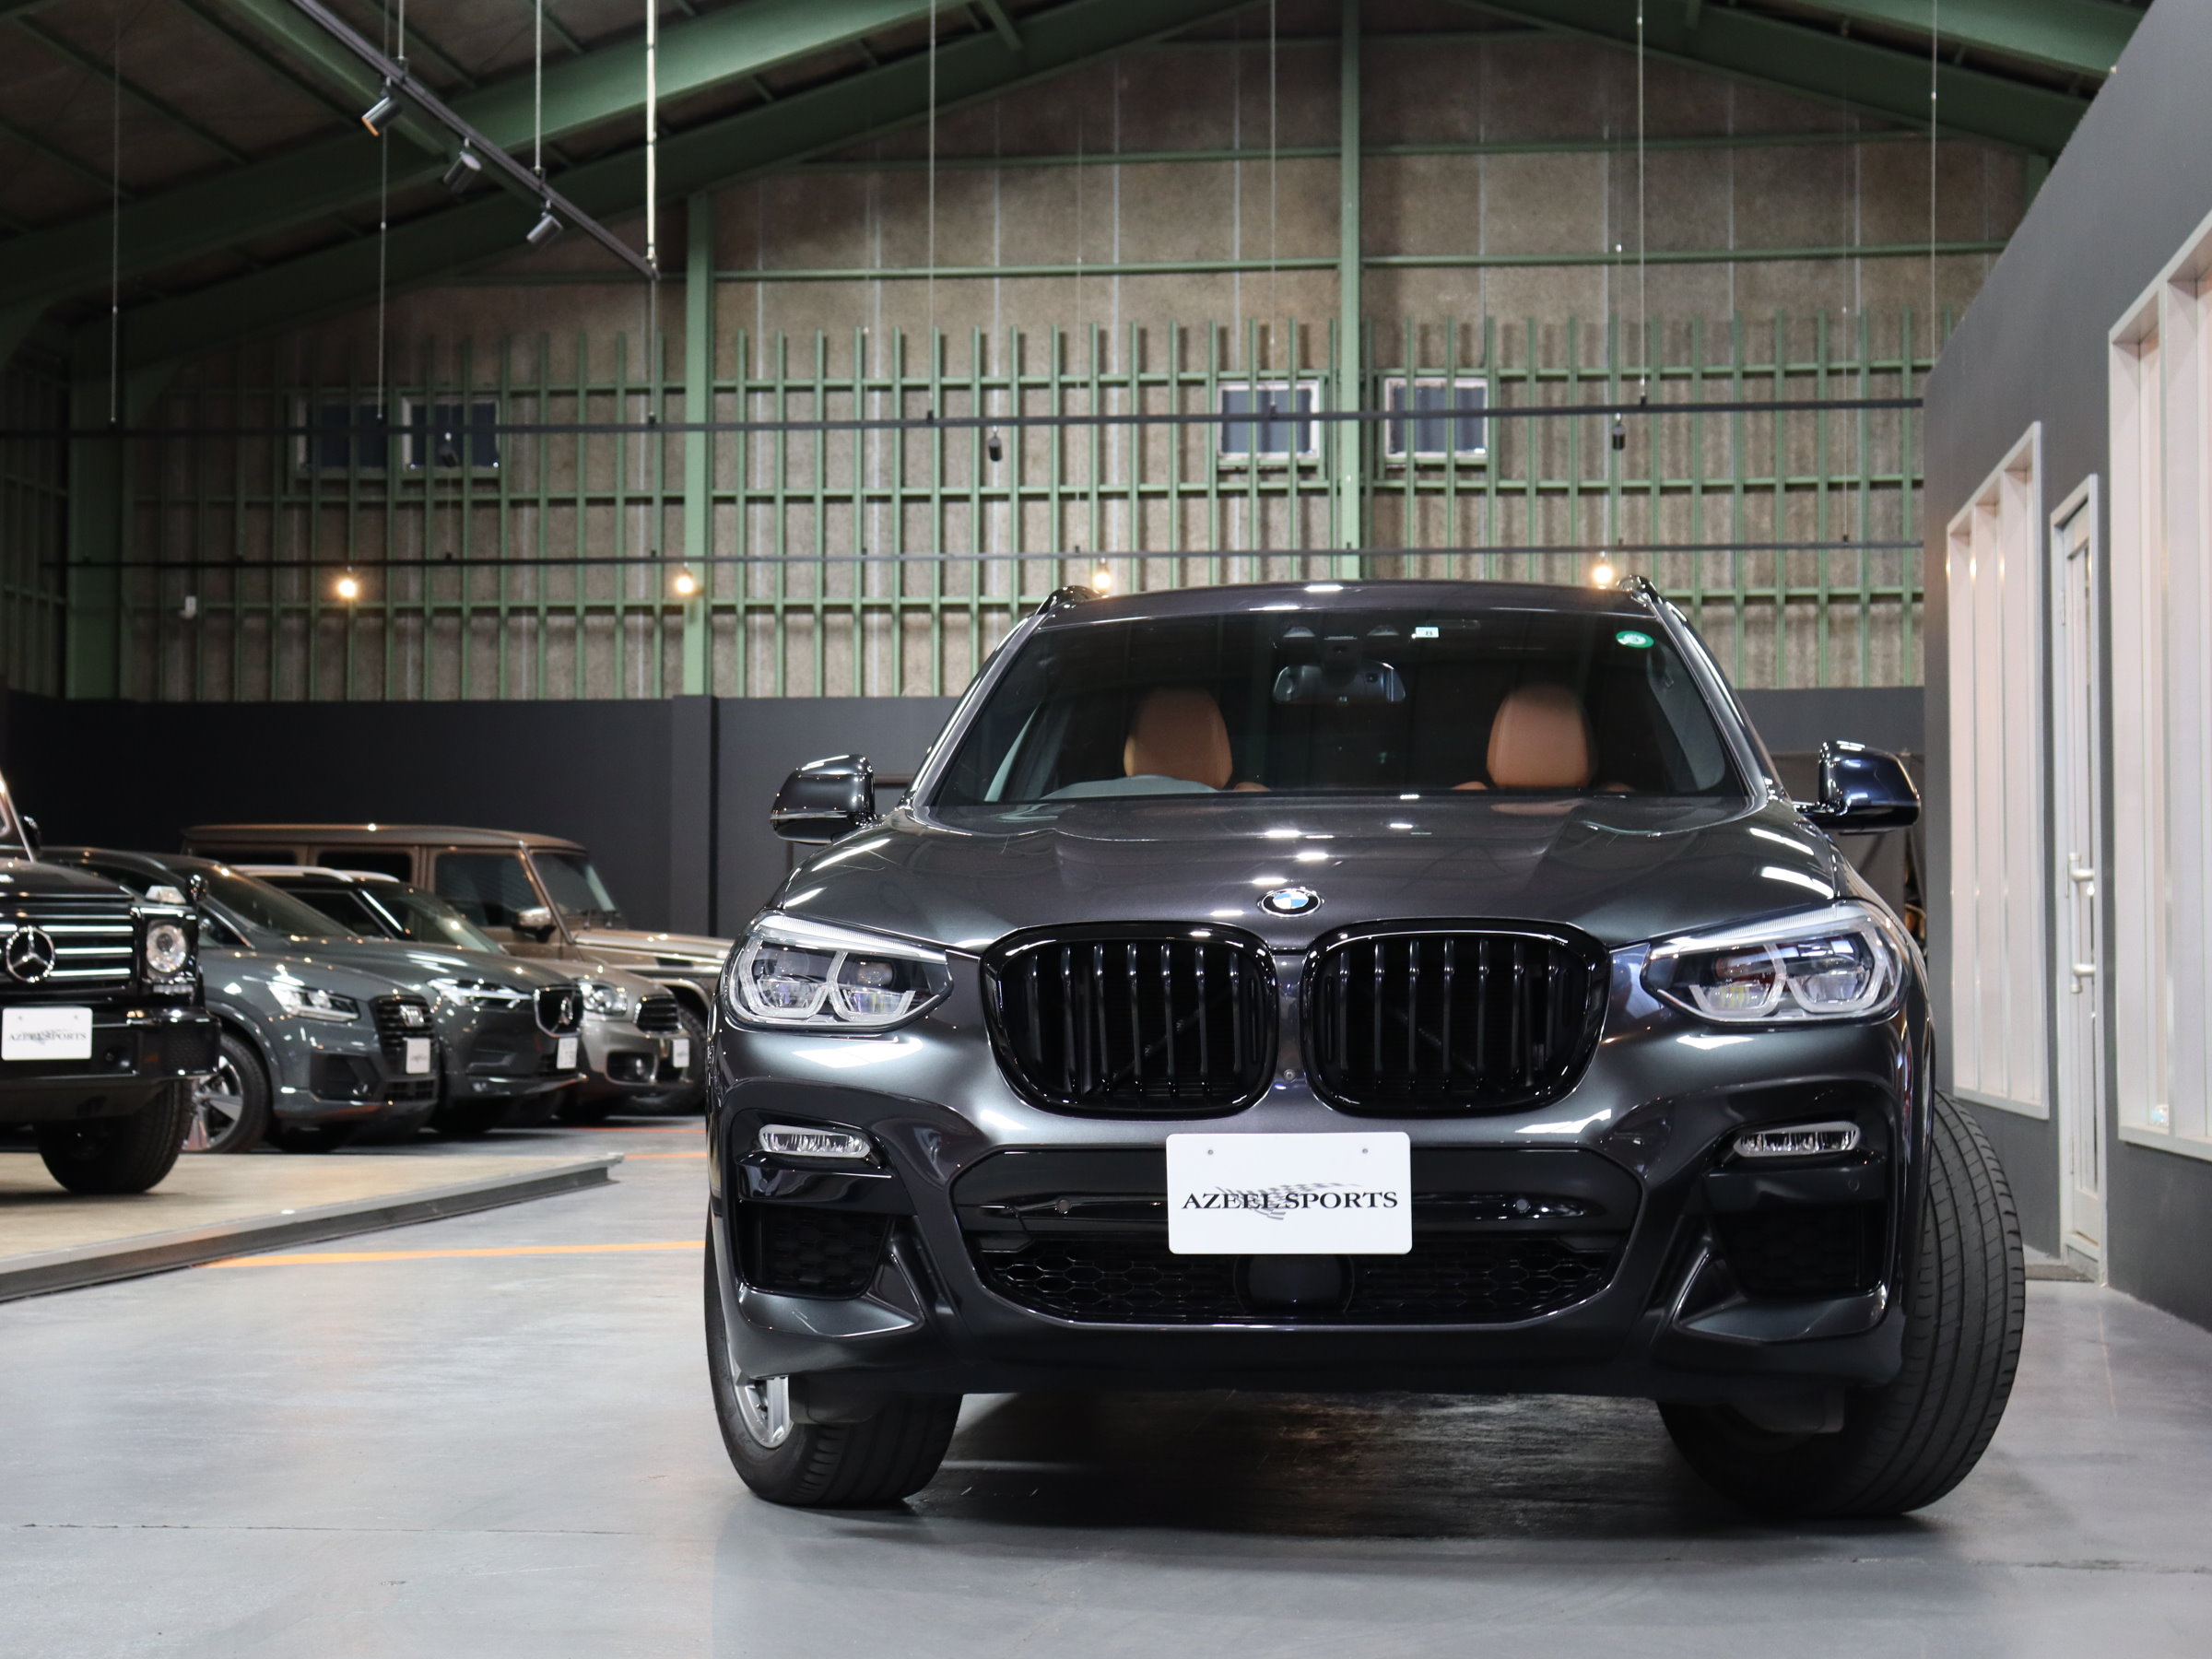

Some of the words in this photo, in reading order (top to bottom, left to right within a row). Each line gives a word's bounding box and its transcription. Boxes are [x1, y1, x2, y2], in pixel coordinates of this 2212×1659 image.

[44, 1031, 87, 1040] SPORTS
[1182, 1193, 1280, 1209] AZEEL
[1284, 1191, 1398, 1209] SPORTS
